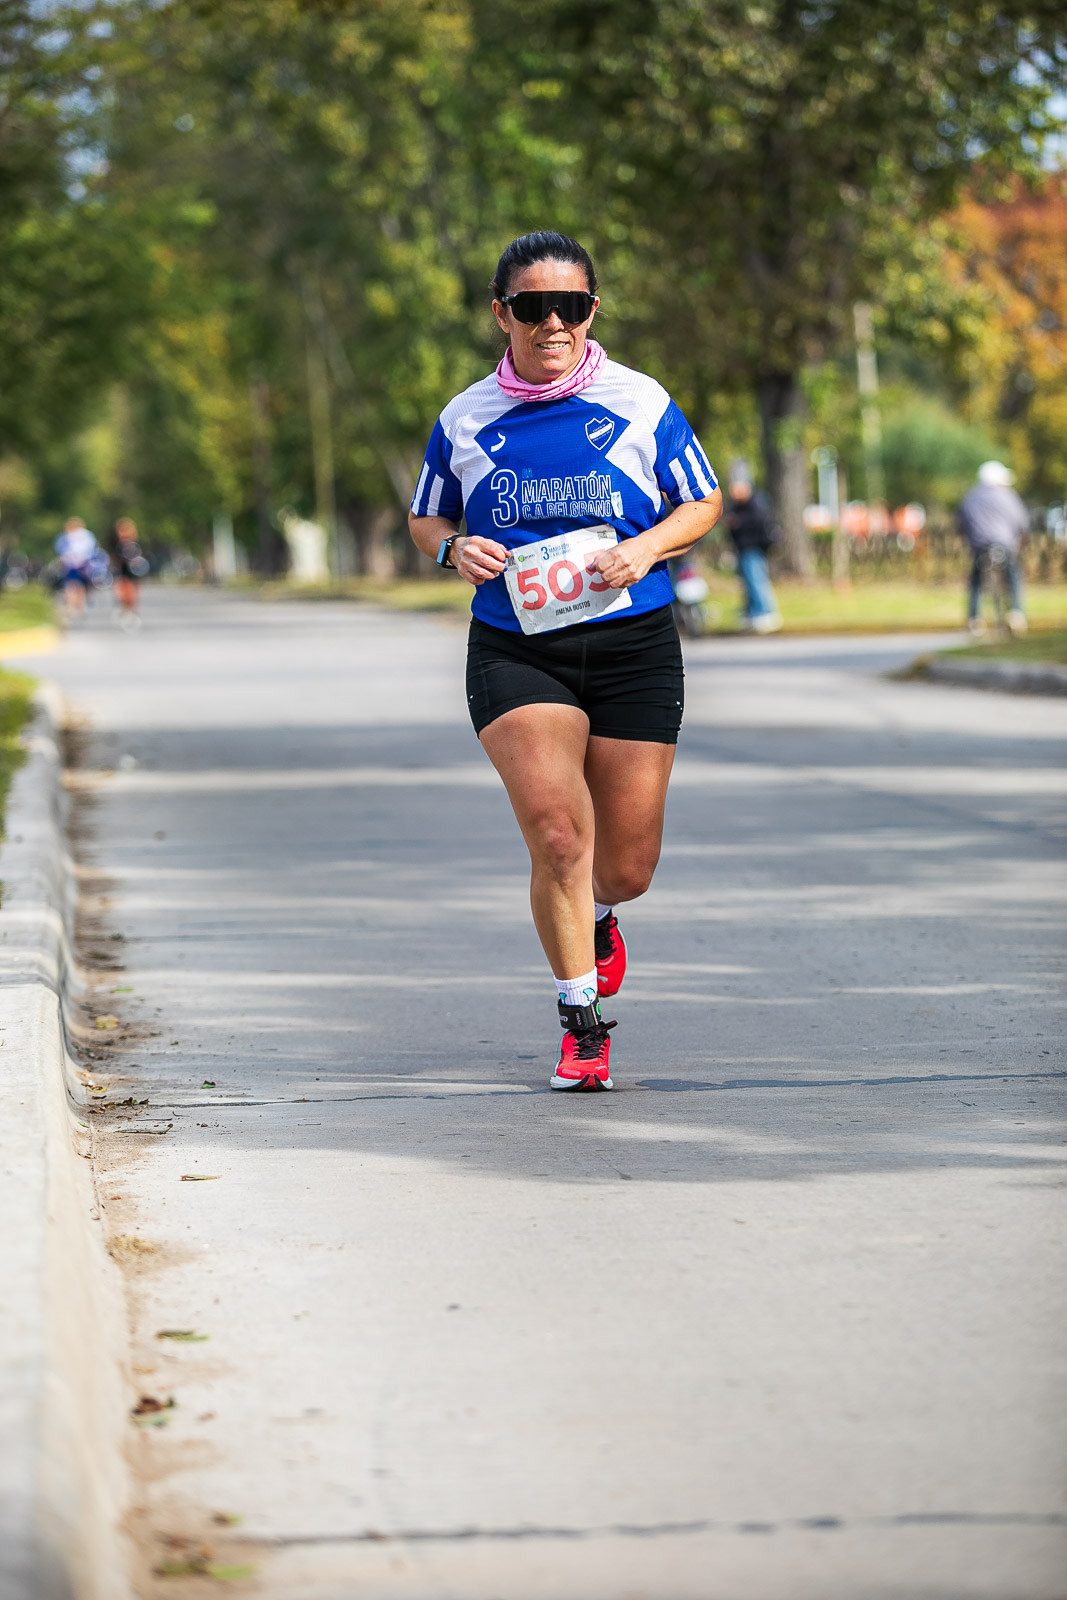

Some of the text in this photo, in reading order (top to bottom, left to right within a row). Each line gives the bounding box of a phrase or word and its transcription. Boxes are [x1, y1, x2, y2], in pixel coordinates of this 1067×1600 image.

[491, 469, 519, 529] 3
[521, 470, 612, 504] MARATÓN
[540, 546, 550, 560] 3
